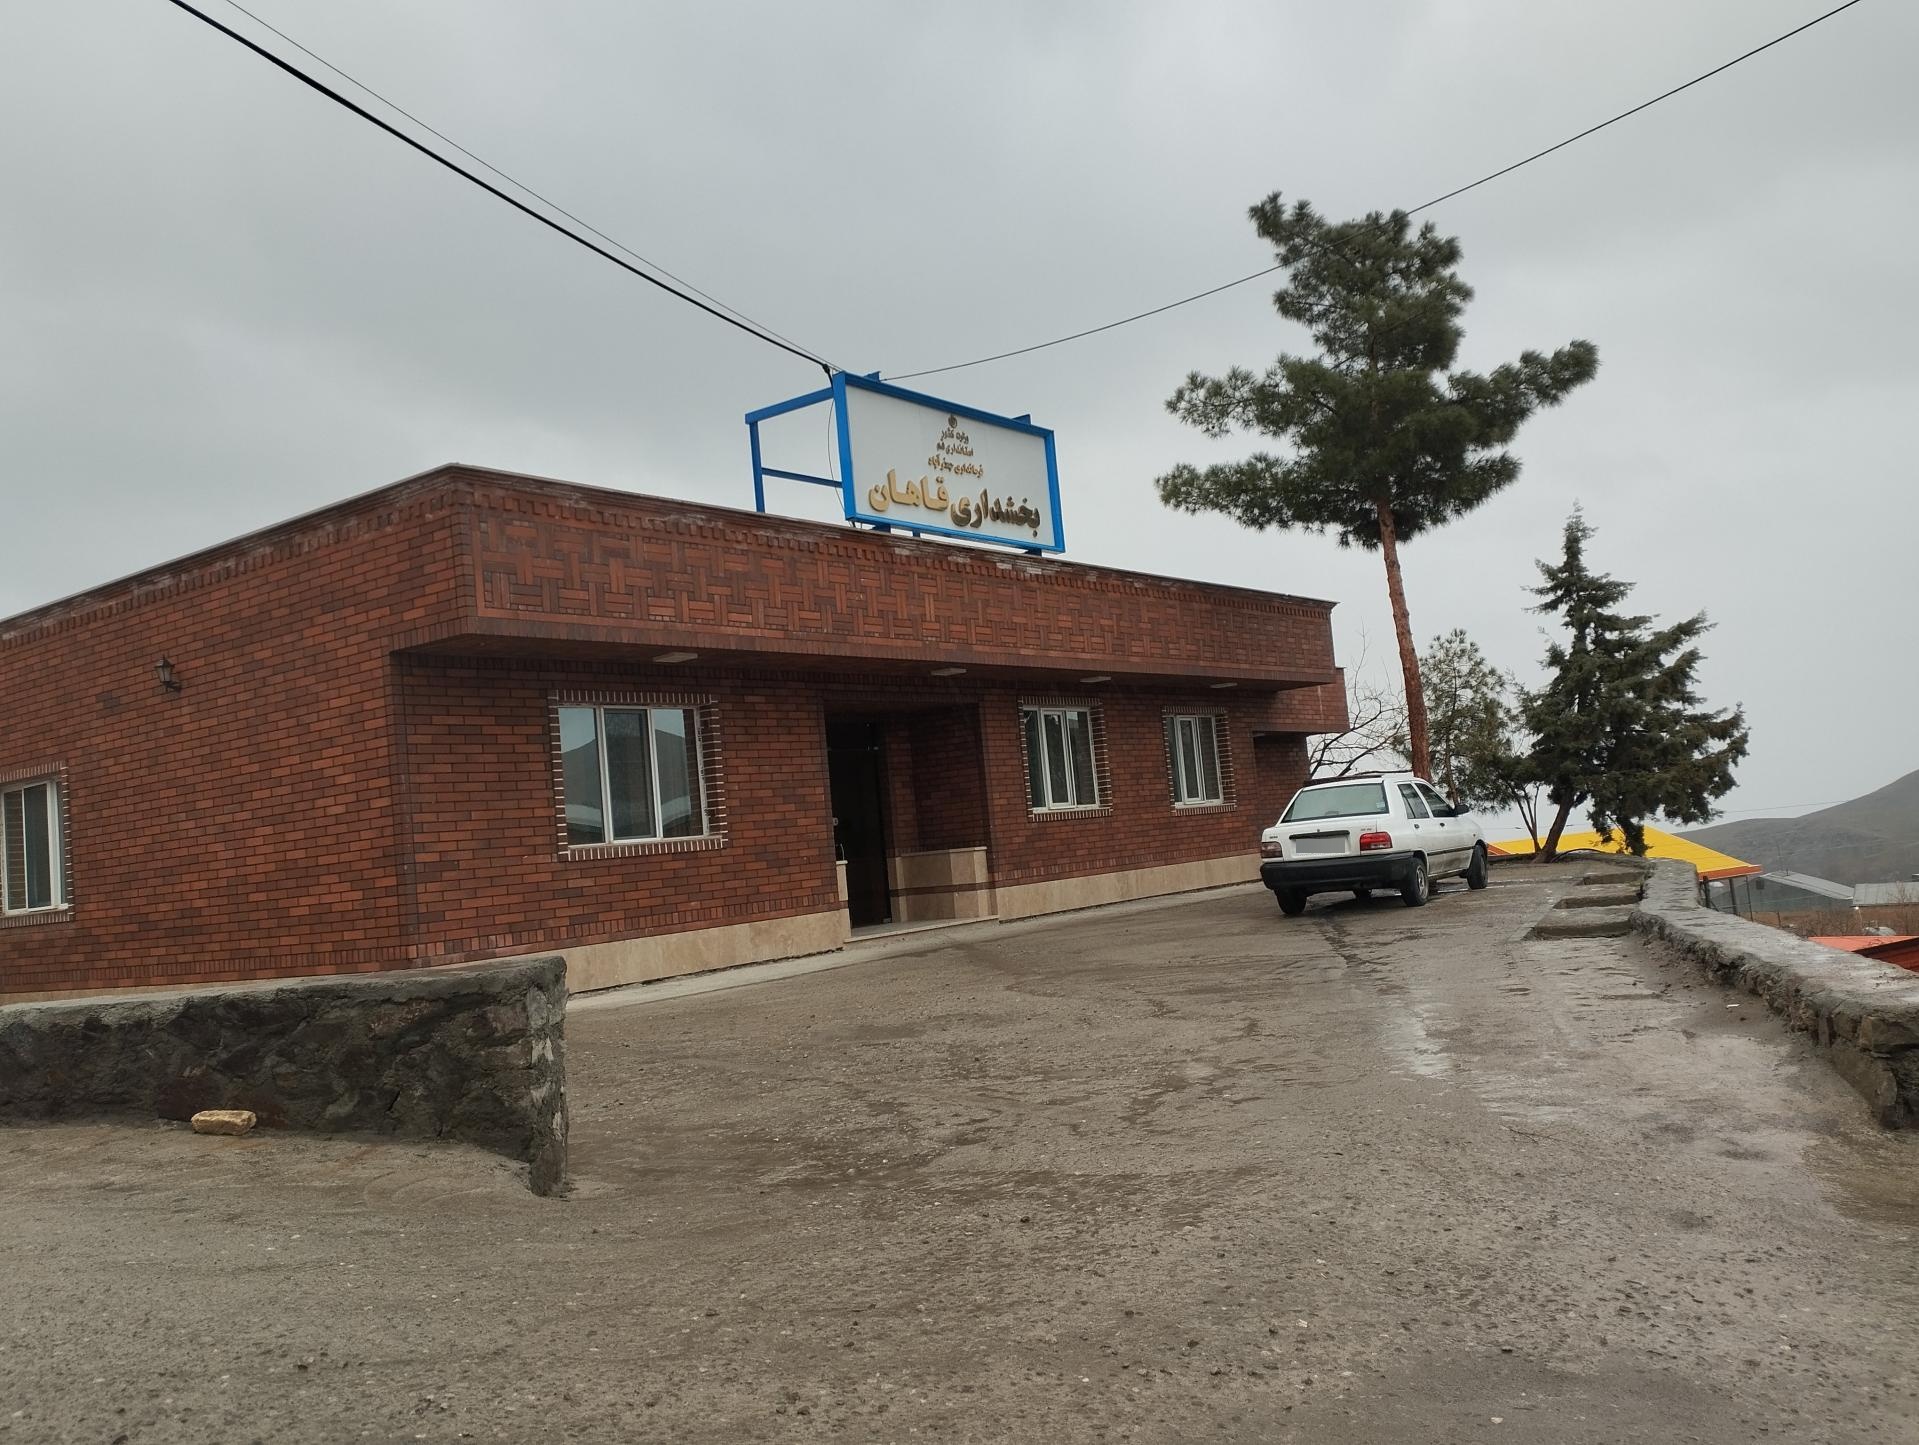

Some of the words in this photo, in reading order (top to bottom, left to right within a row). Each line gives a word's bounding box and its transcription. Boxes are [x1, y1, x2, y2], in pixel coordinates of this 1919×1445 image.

[946, 443, 974, 457] استانداری
[954, 463, 984, 478] فرمانداری
[868, 468, 949, 512] قاهان
[951, 488, 1040, 537] بخشداری
